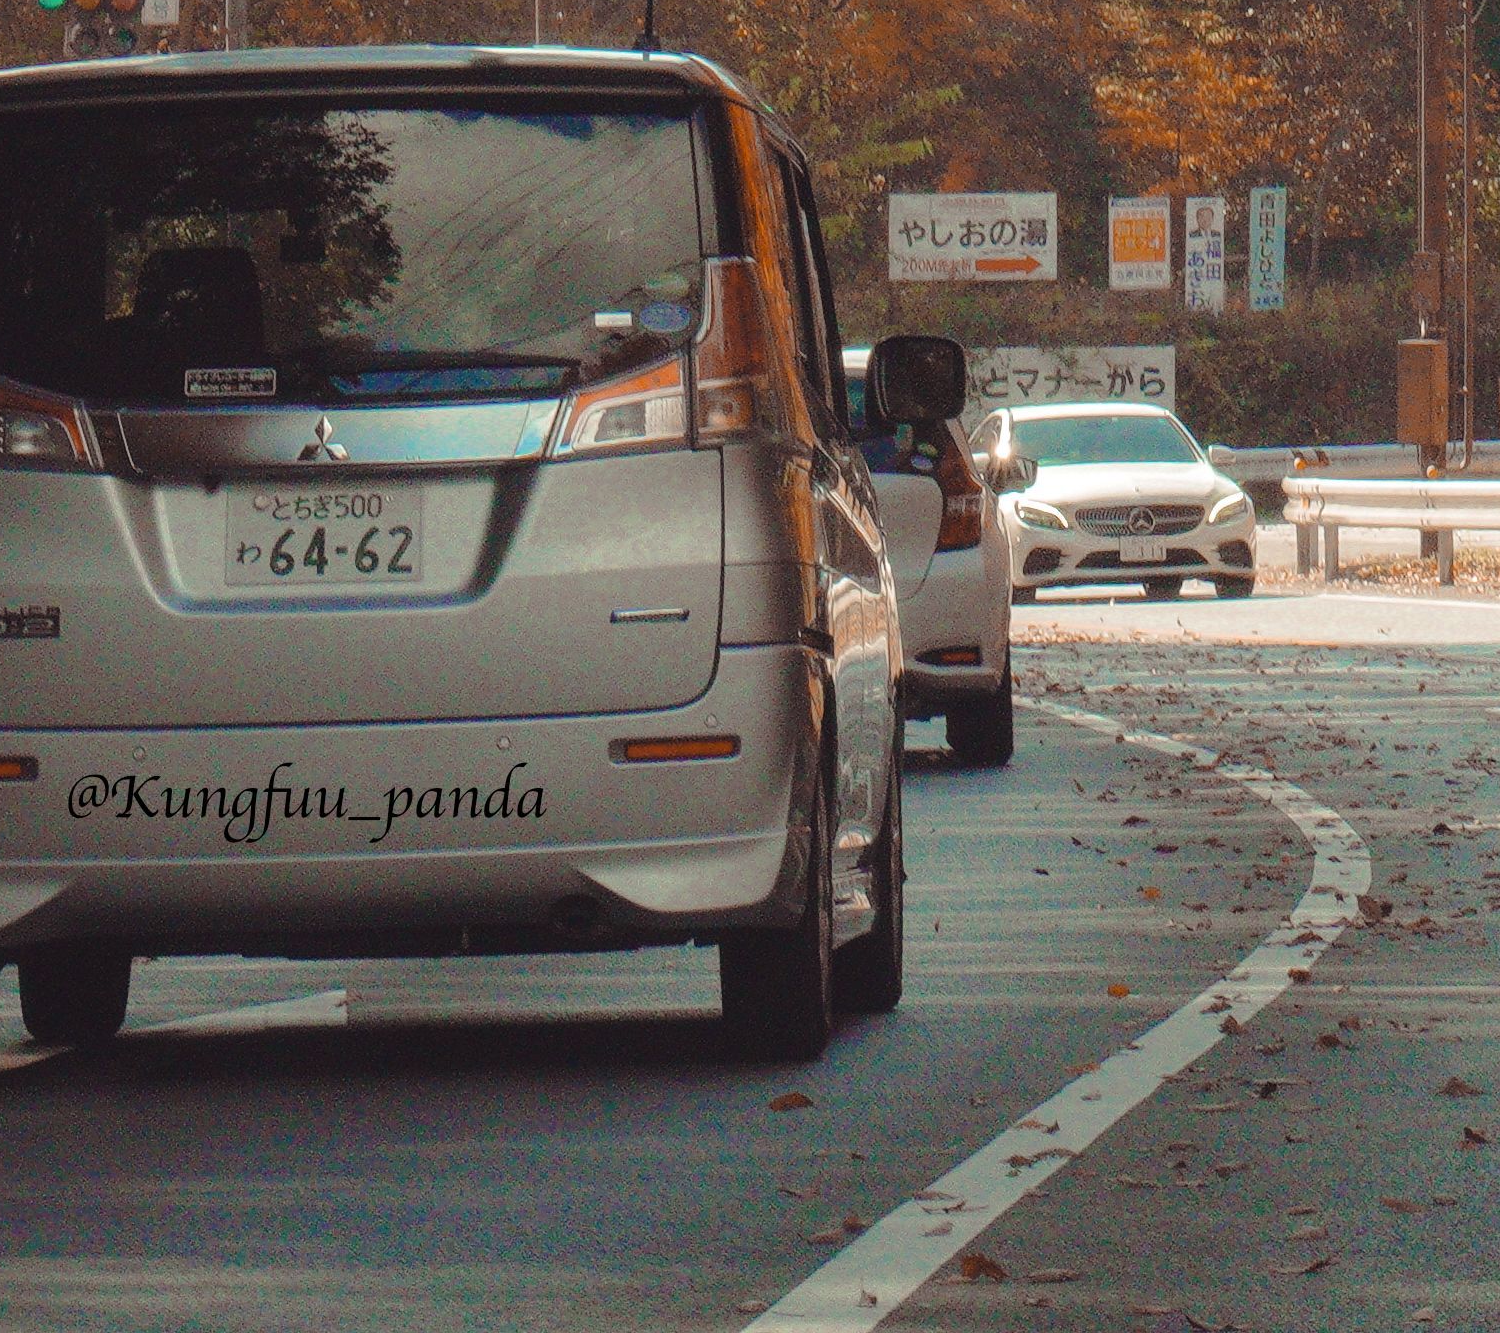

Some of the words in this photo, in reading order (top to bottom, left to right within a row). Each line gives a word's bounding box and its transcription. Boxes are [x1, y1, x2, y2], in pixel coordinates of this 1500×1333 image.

[899, 218, 1048, 247] やしおの湯
[1206, 240, 1222, 281] 福田
[967, 365, 1166, 399] とマナーから
[236, 540, 262, 565] わ
[269, 525, 414, 577] 64-62
